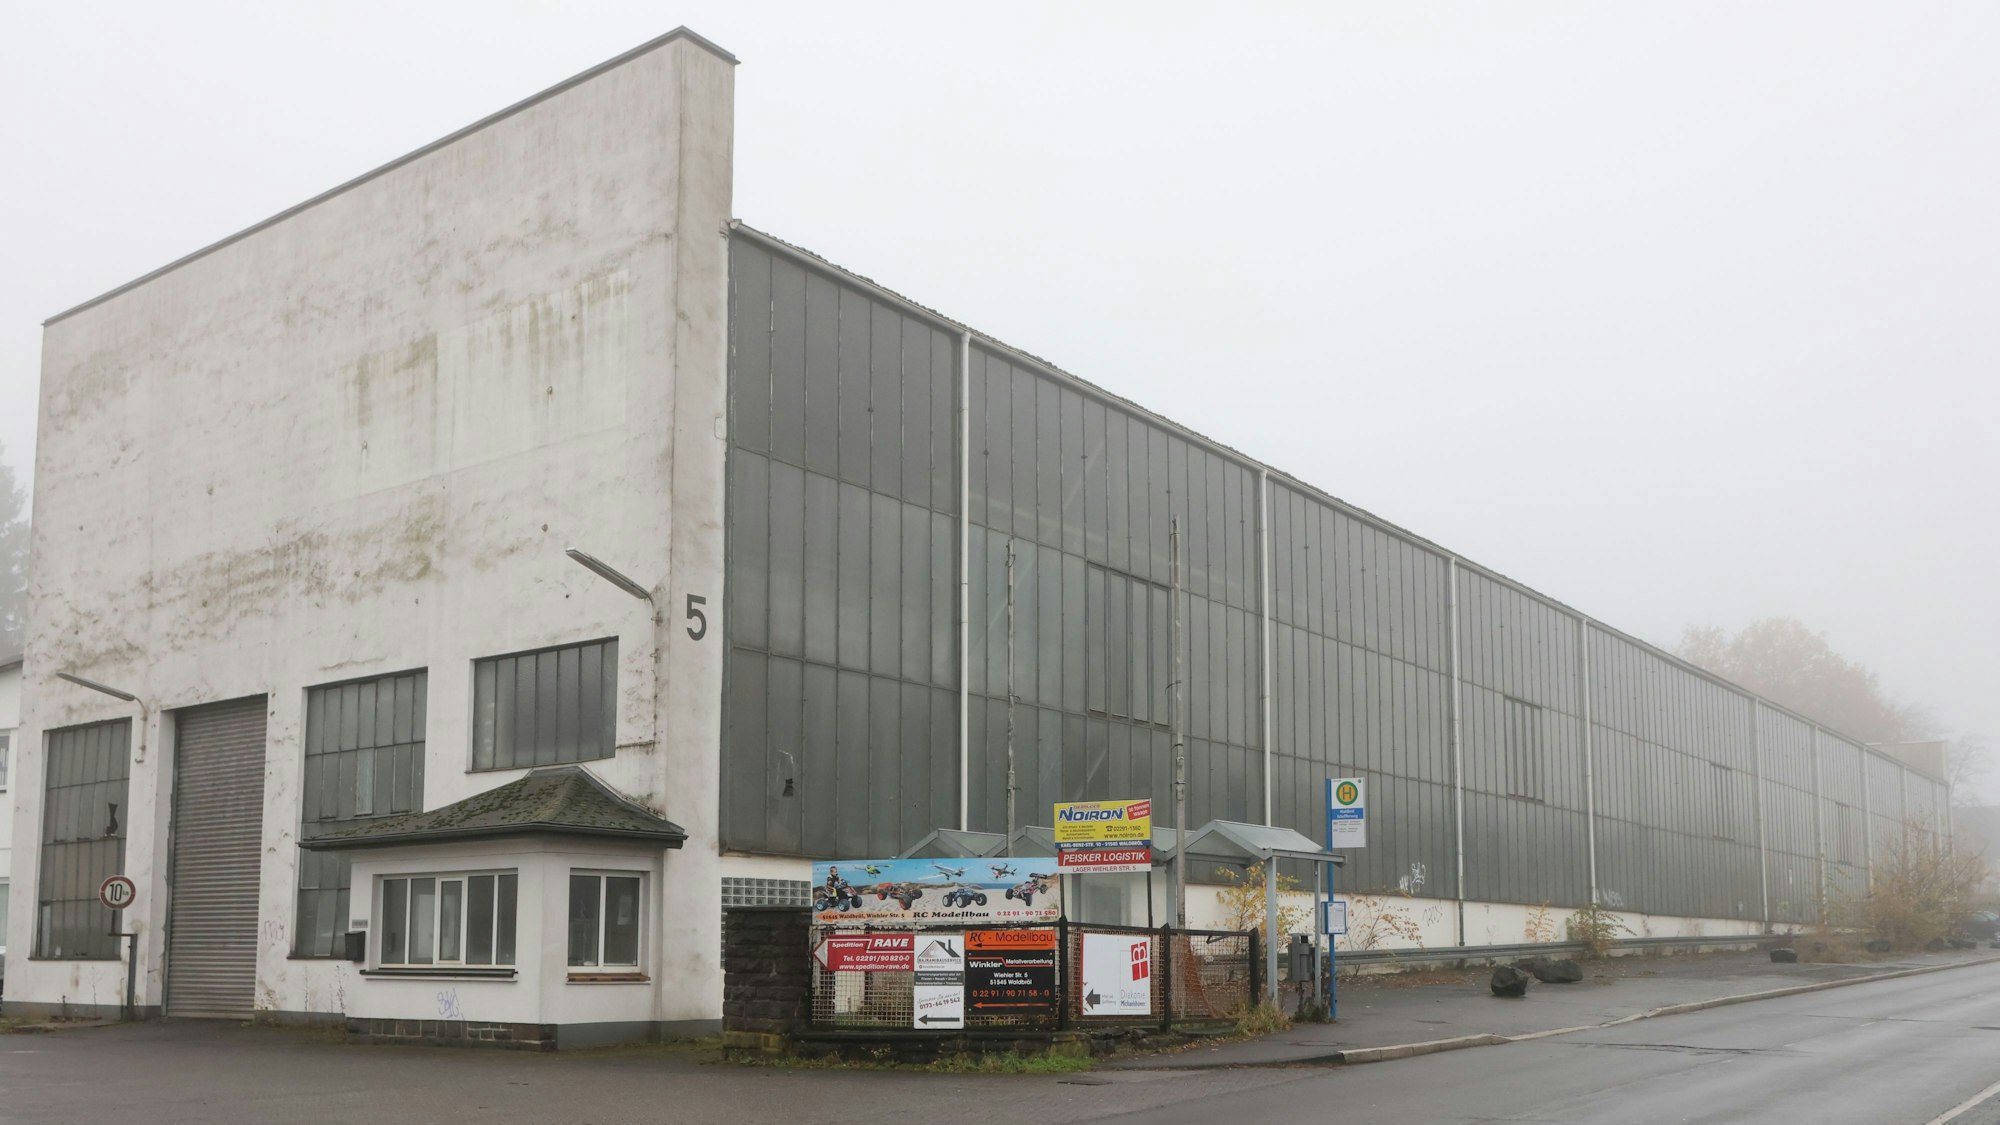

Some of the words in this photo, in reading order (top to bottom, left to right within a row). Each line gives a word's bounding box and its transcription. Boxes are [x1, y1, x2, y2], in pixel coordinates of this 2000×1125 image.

[686, 593, 706, 641] 5
[1342, 786, 1352, 800] H
[1058, 806, 1123, 821] NOIRON
[1063, 853, 1102, 866] PEISKER
[1104, 852, 1145, 862] LOGISTIK
[109, 883, 123, 901] 10
[874, 939, 909, 947] RAVE
[969, 932, 986, 942] RC
[995, 932, 1053, 942] Modellbau
[1120, 990, 1146, 999] Diakonie
